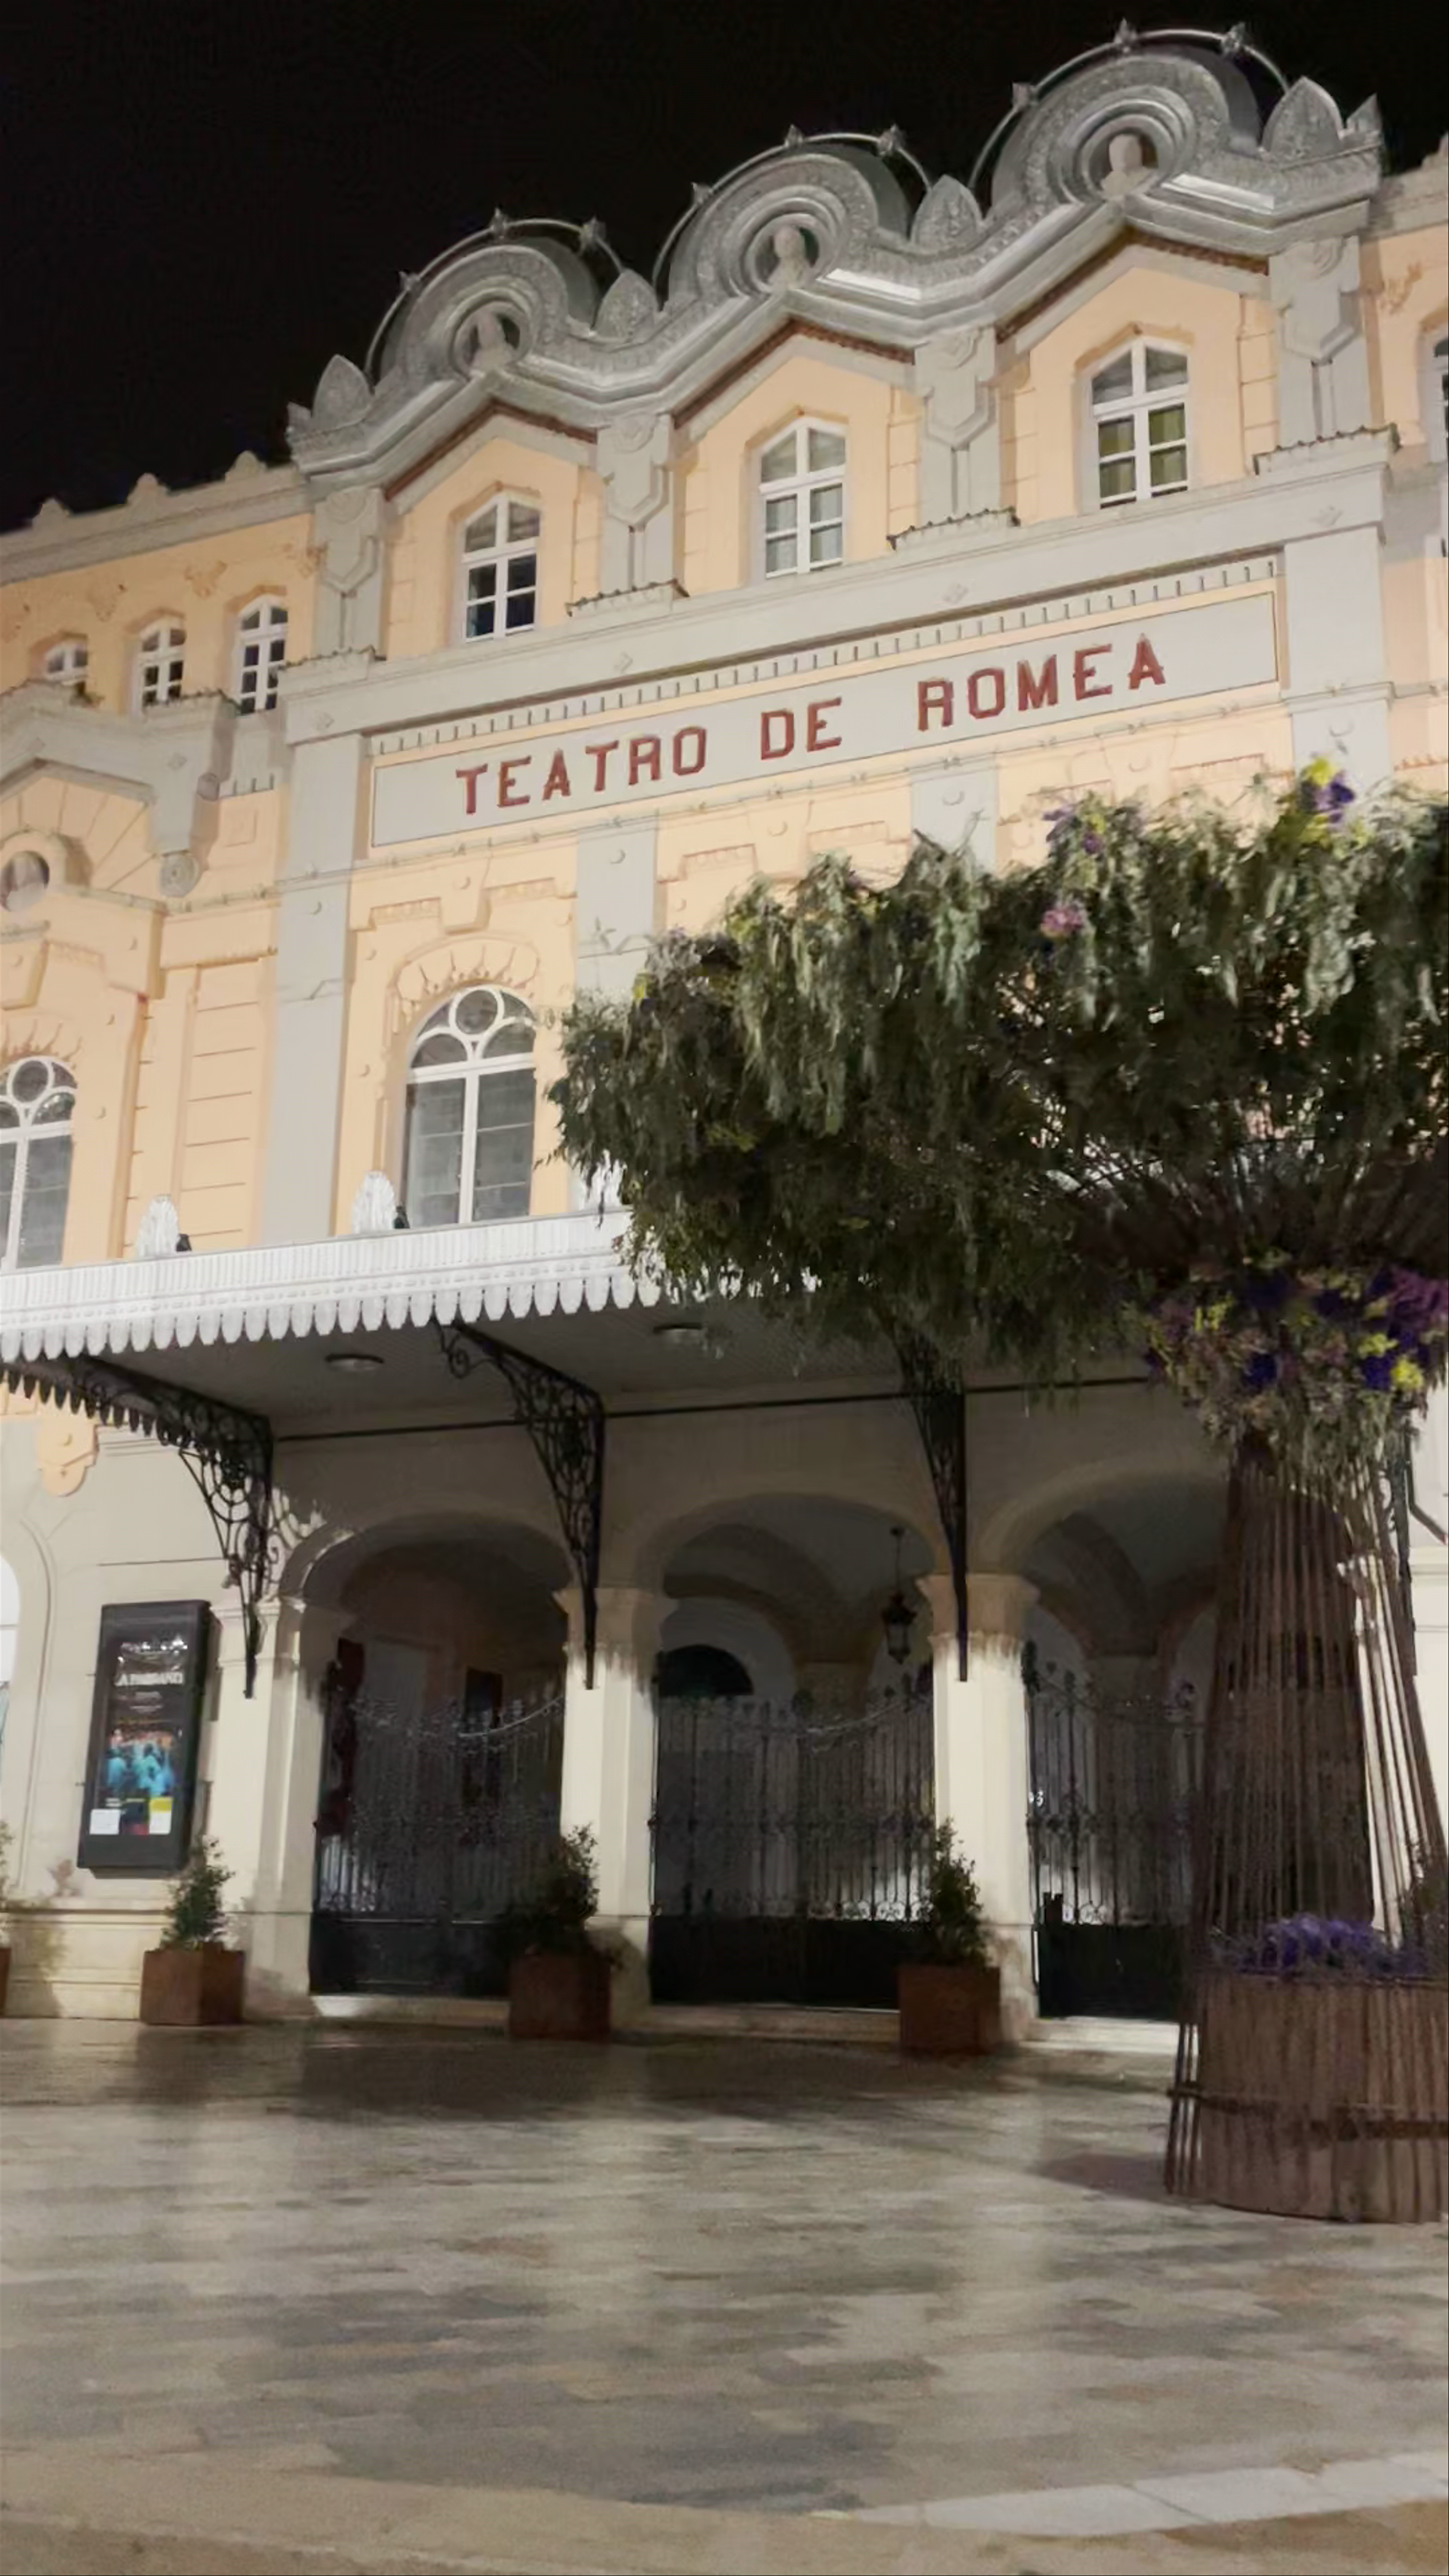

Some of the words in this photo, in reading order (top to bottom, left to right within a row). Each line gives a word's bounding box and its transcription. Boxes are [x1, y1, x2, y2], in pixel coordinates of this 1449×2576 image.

[456, 726, 707, 816] TEATRO
[760, 697, 842, 761] DE
[917, 634, 1166, 731] ROMEA
